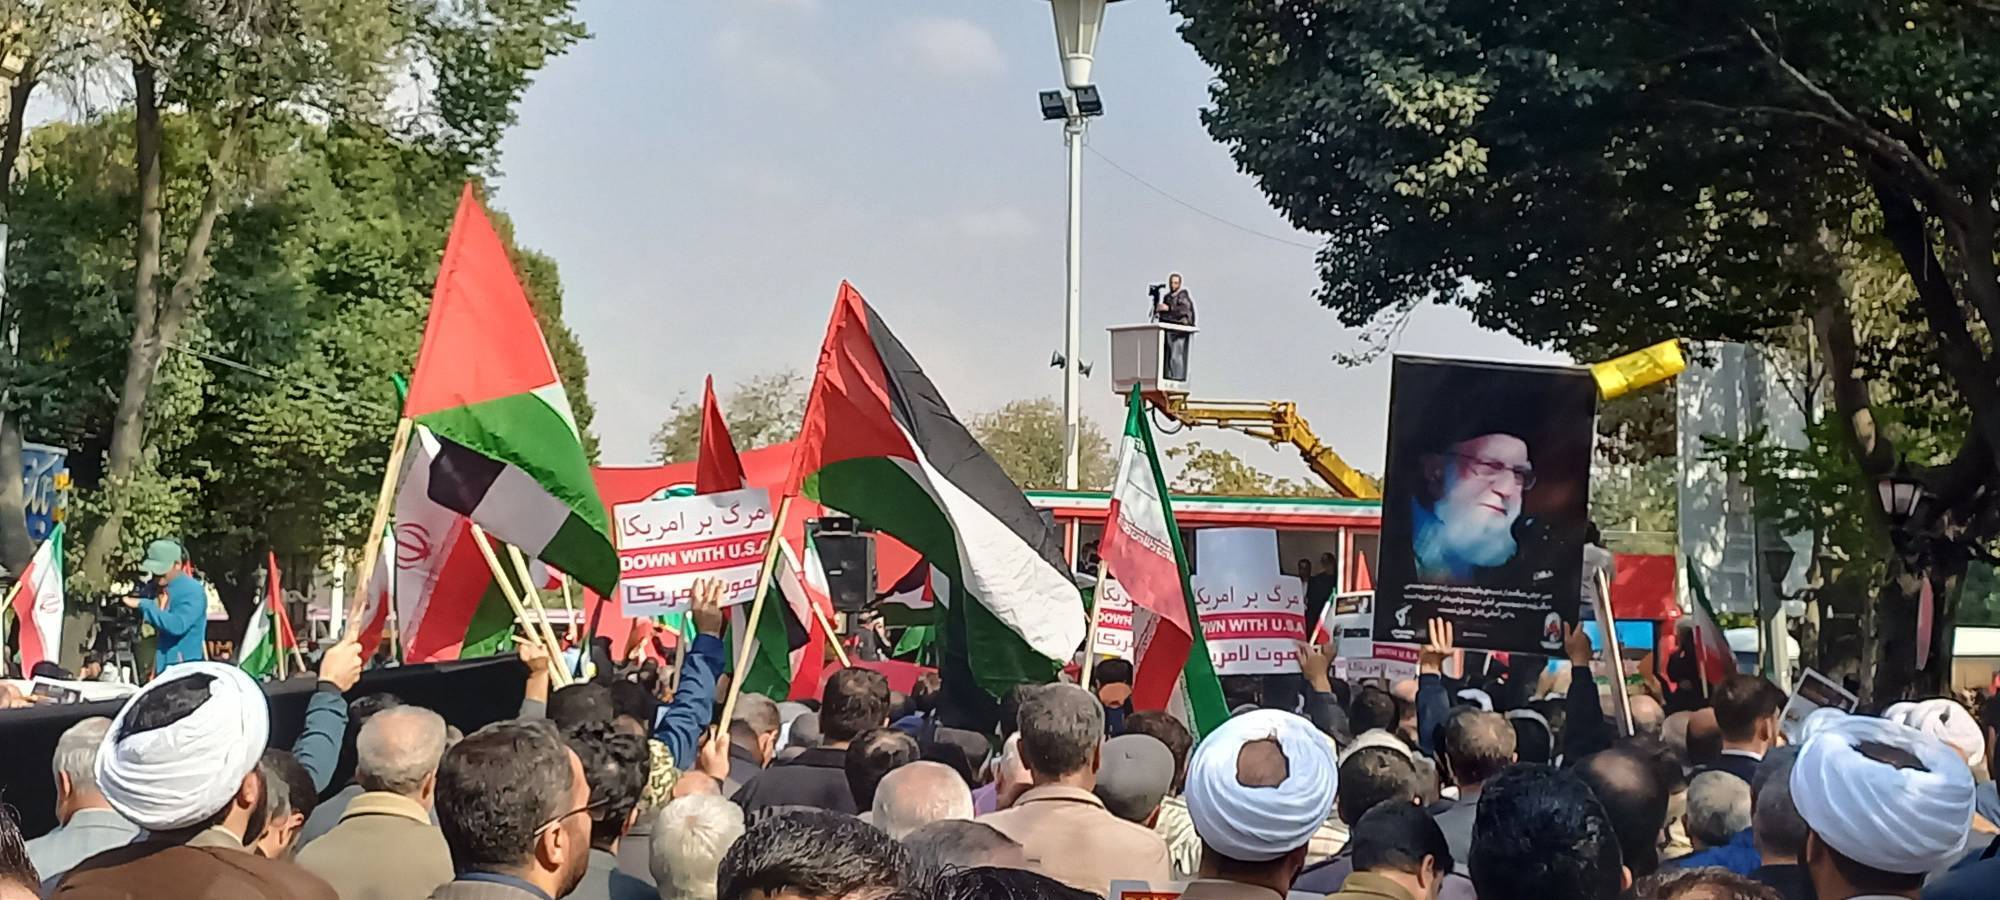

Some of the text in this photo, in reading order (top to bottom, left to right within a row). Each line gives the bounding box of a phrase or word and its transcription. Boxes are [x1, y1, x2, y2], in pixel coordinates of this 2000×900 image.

[695, 515, 713, 535] بر
[620, 552, 677, 571] DOWN
[680, 545, 726, 564] WITH
[1242, 592, 1259, 609] بر
[1202, 619, 1226, 634] WN
[1228, 617, 1269, 633] WITH
